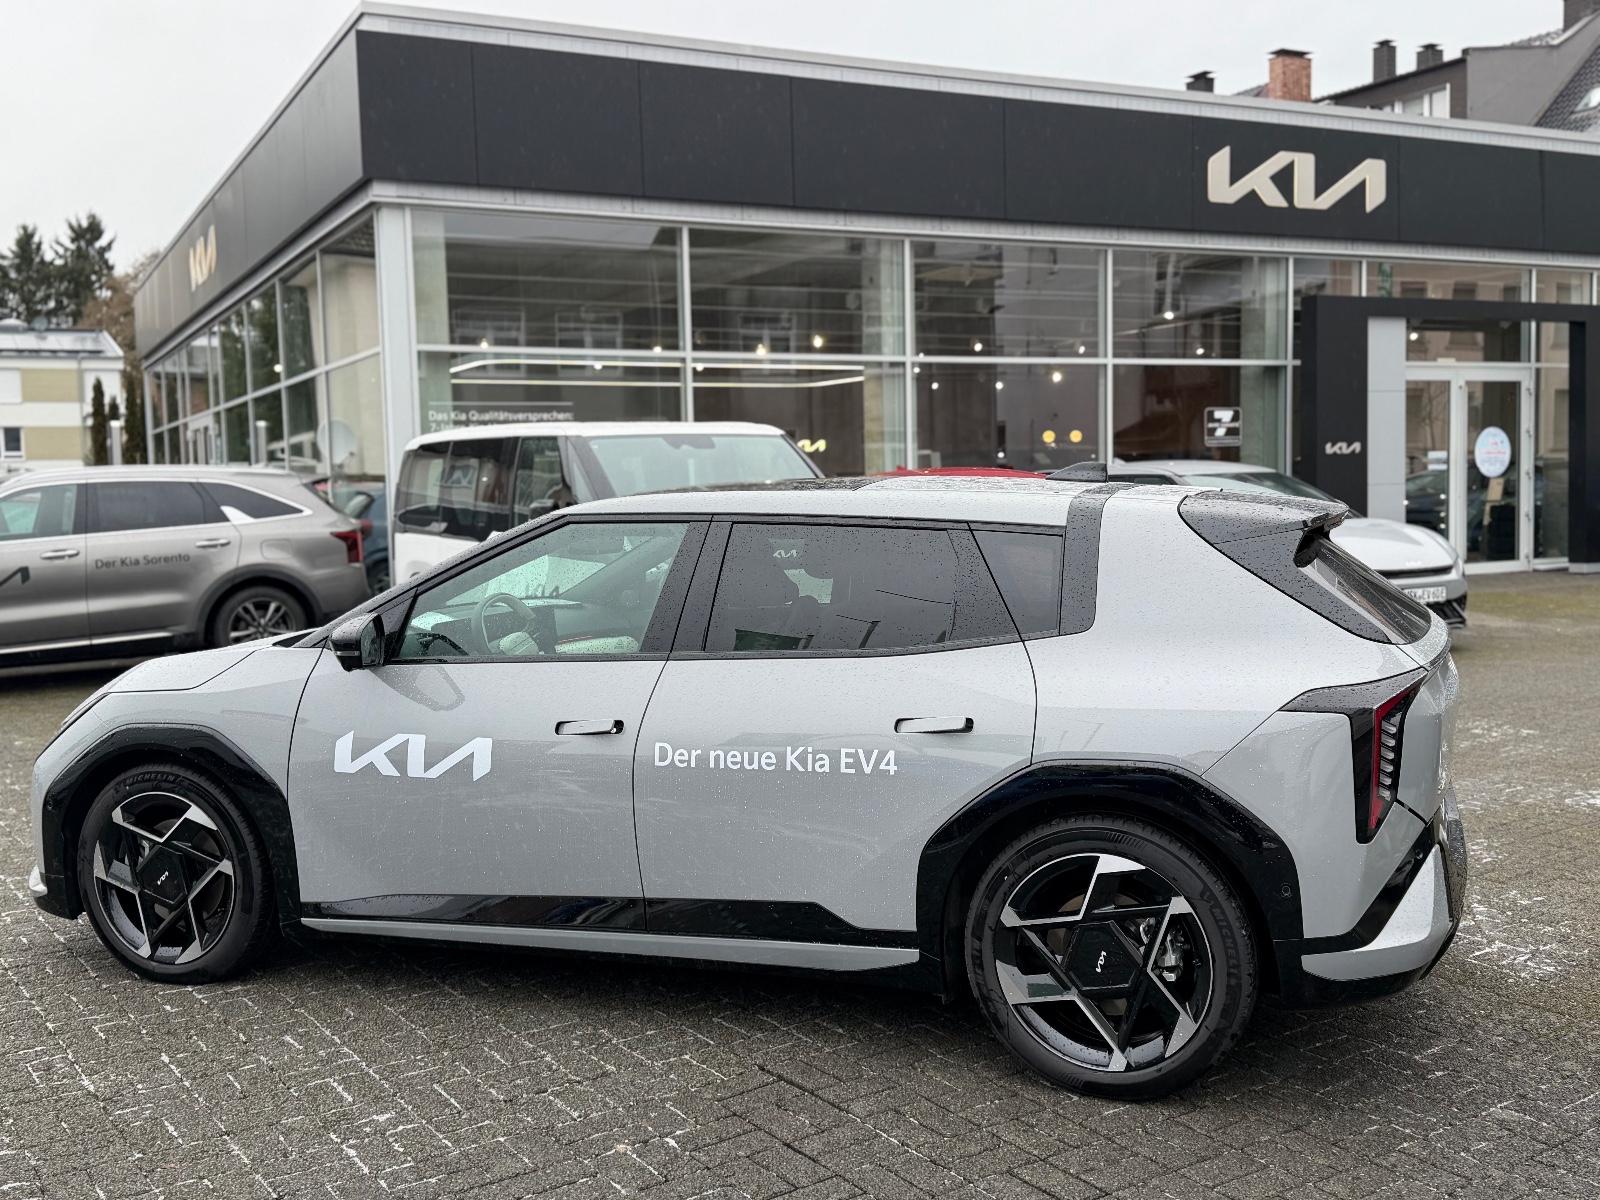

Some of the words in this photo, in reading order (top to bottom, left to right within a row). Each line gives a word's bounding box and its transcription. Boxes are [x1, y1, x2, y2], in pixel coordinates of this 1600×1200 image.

[1207, 145, 1387, 214] KIA
[428, 411, 448, 421] Das
[451, 411, 467, 421] Kia
[1325, 441, 1362, 455] KIA
[95, 559, 116, 570] Der
[120, 556, 140, 568] Kia
[143, 553, 190, 566] Sorento
[334, 730, 493, 782] KIA
[654, 742, 701, 767] Der
[709, 750, 777, 770] neue
[786, 746, 830, 774] Kia
[840, 748, 898, 775] EV4
[125, 773, 175, 785] MICHELIN
